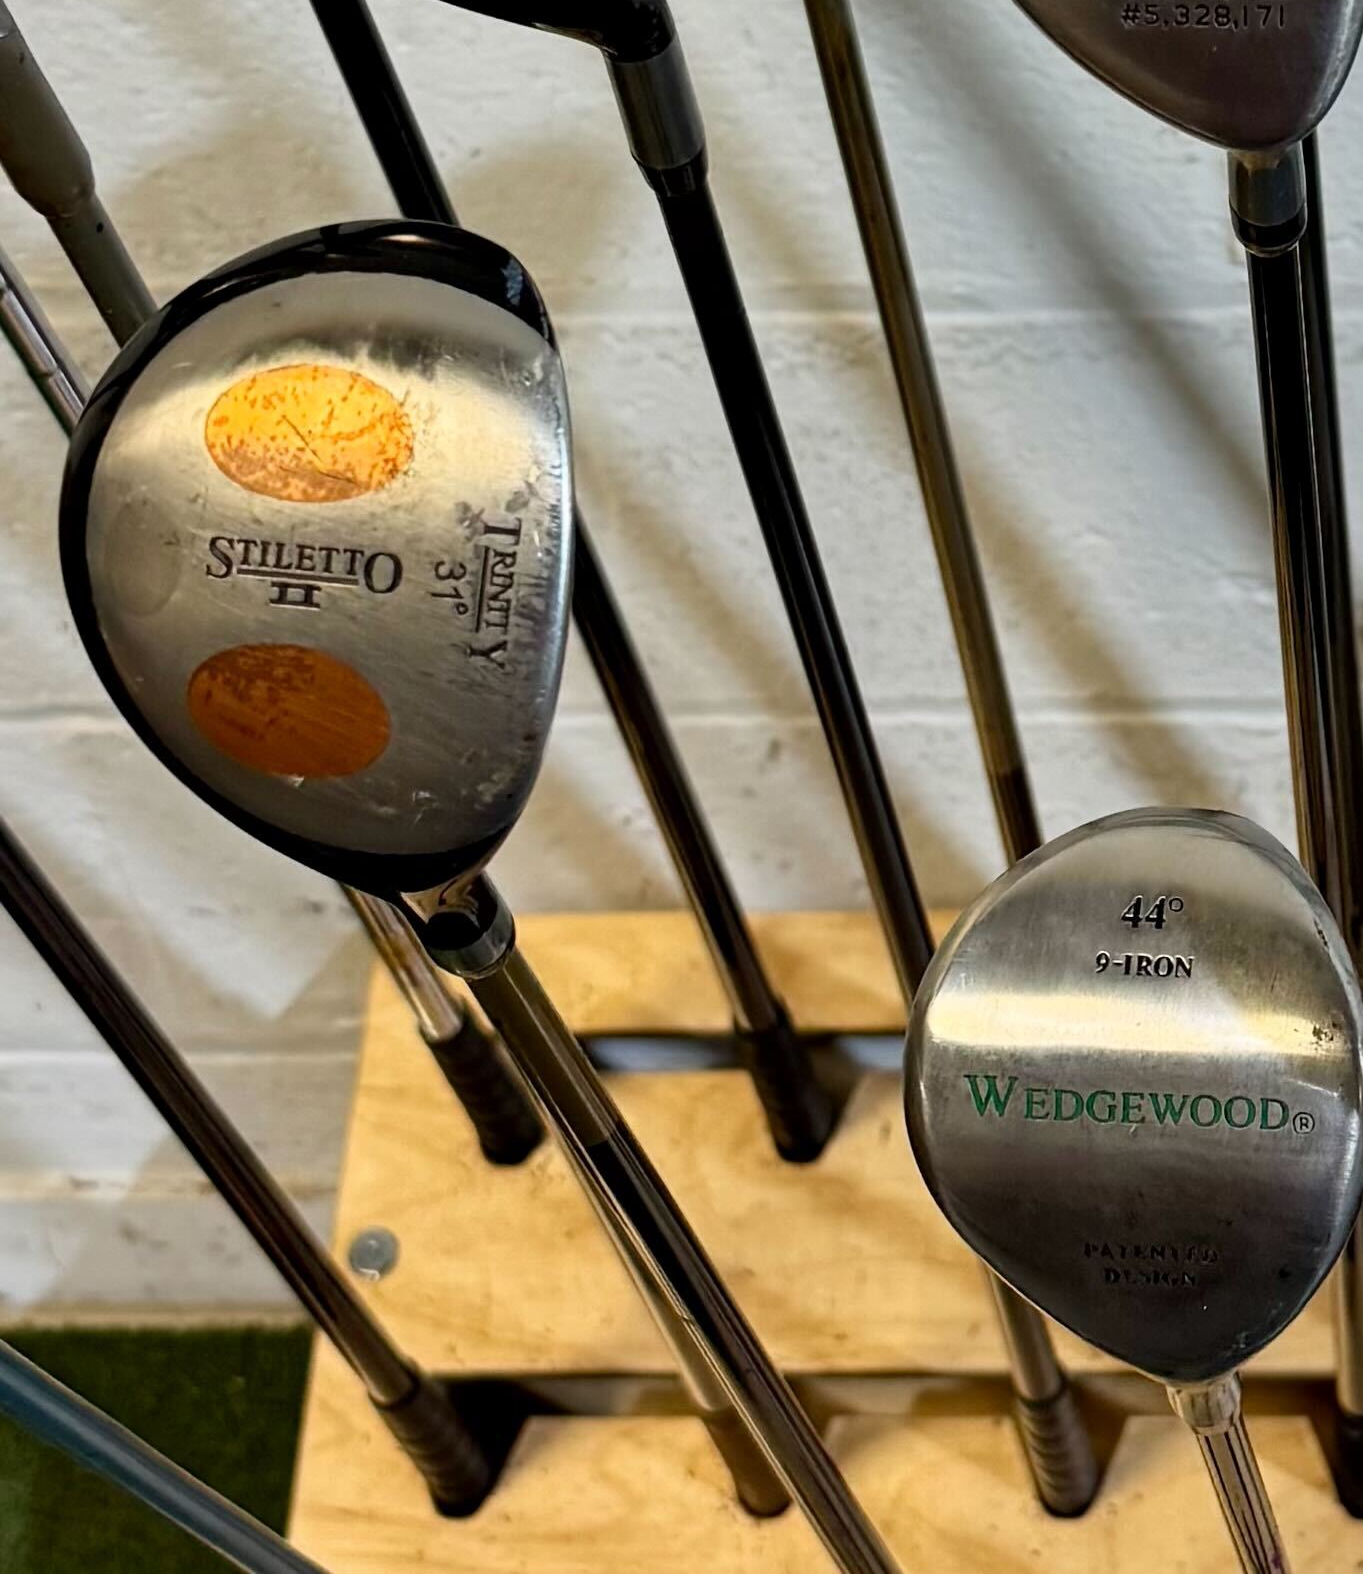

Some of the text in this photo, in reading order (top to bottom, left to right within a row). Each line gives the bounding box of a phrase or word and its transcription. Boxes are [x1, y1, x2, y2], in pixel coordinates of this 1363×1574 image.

[205, 535, 403, 595] STILETTO
[268, 580, 323, 609] II
[466, 516, 523, 671] TRINITY
[1120, 894, 1185, 930] 44°
[1095, 950, 1196, 979] 9-IRON
